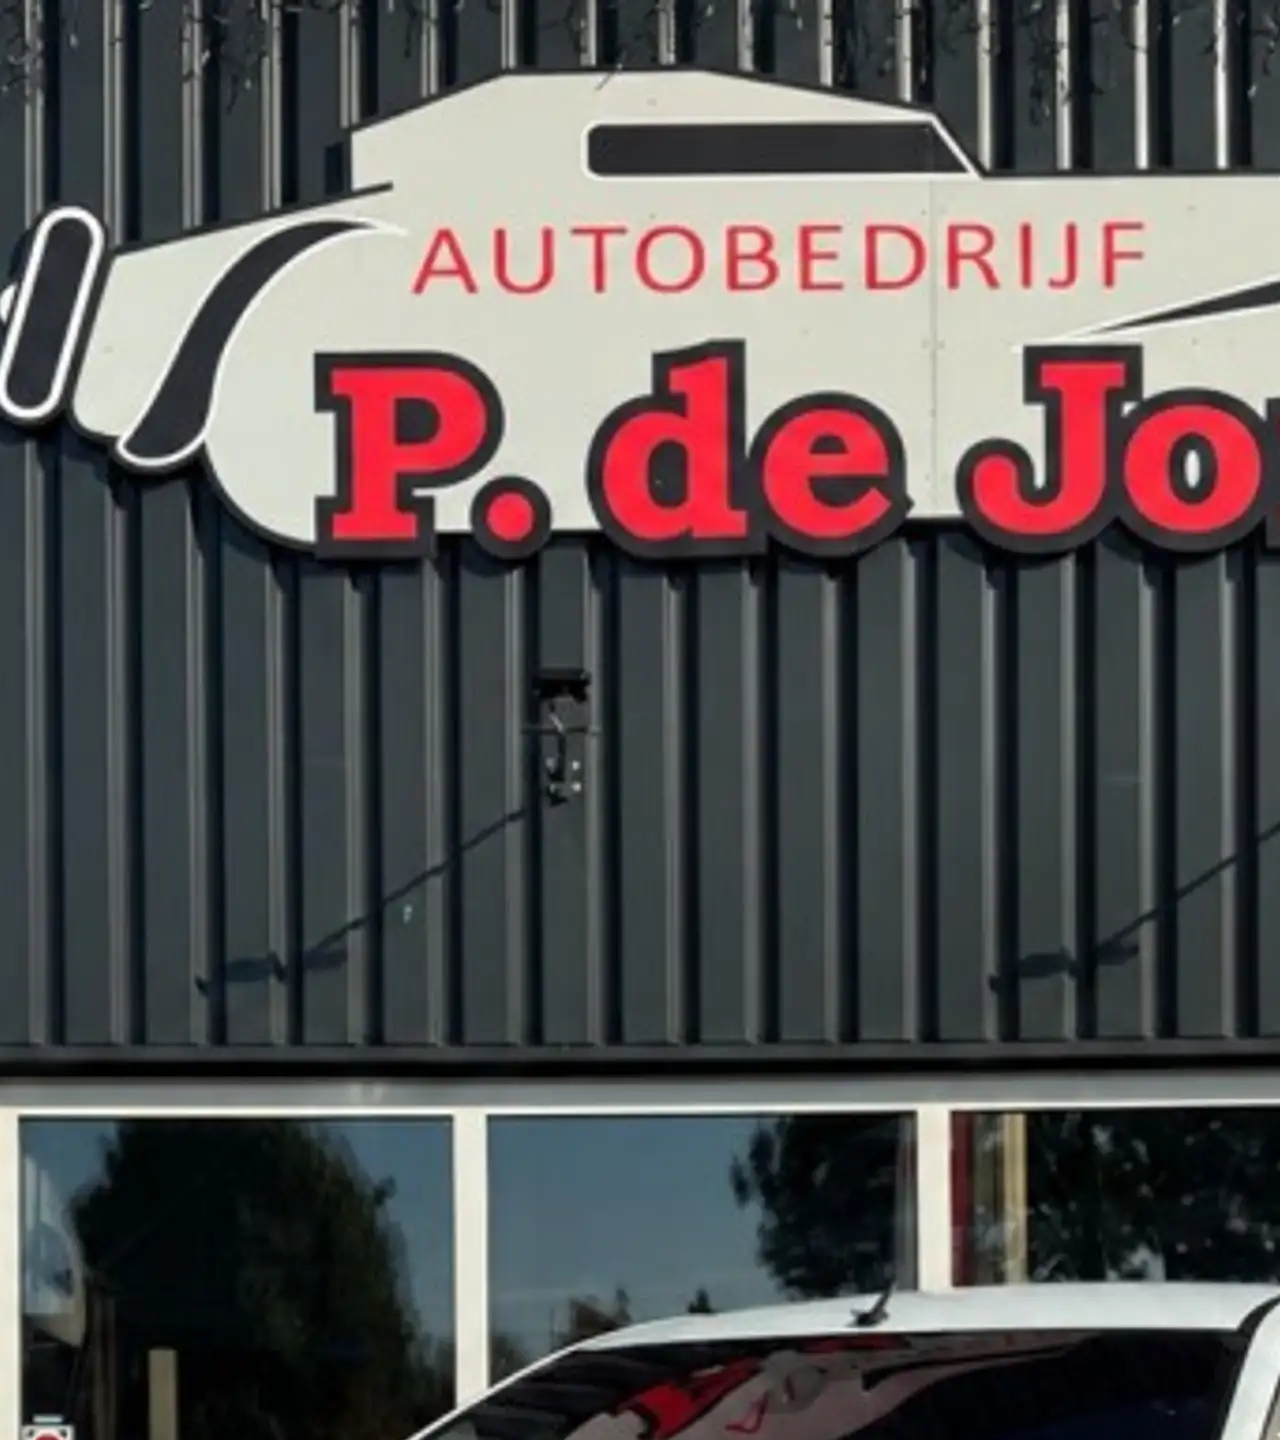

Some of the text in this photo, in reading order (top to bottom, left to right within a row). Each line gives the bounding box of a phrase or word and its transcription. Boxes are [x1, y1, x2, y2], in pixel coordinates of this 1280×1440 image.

[411, 222, 1147, 296] AUTOBEDRIJF
[325, 362, 540, 546] P.
[598, 352, 896, 546] de
